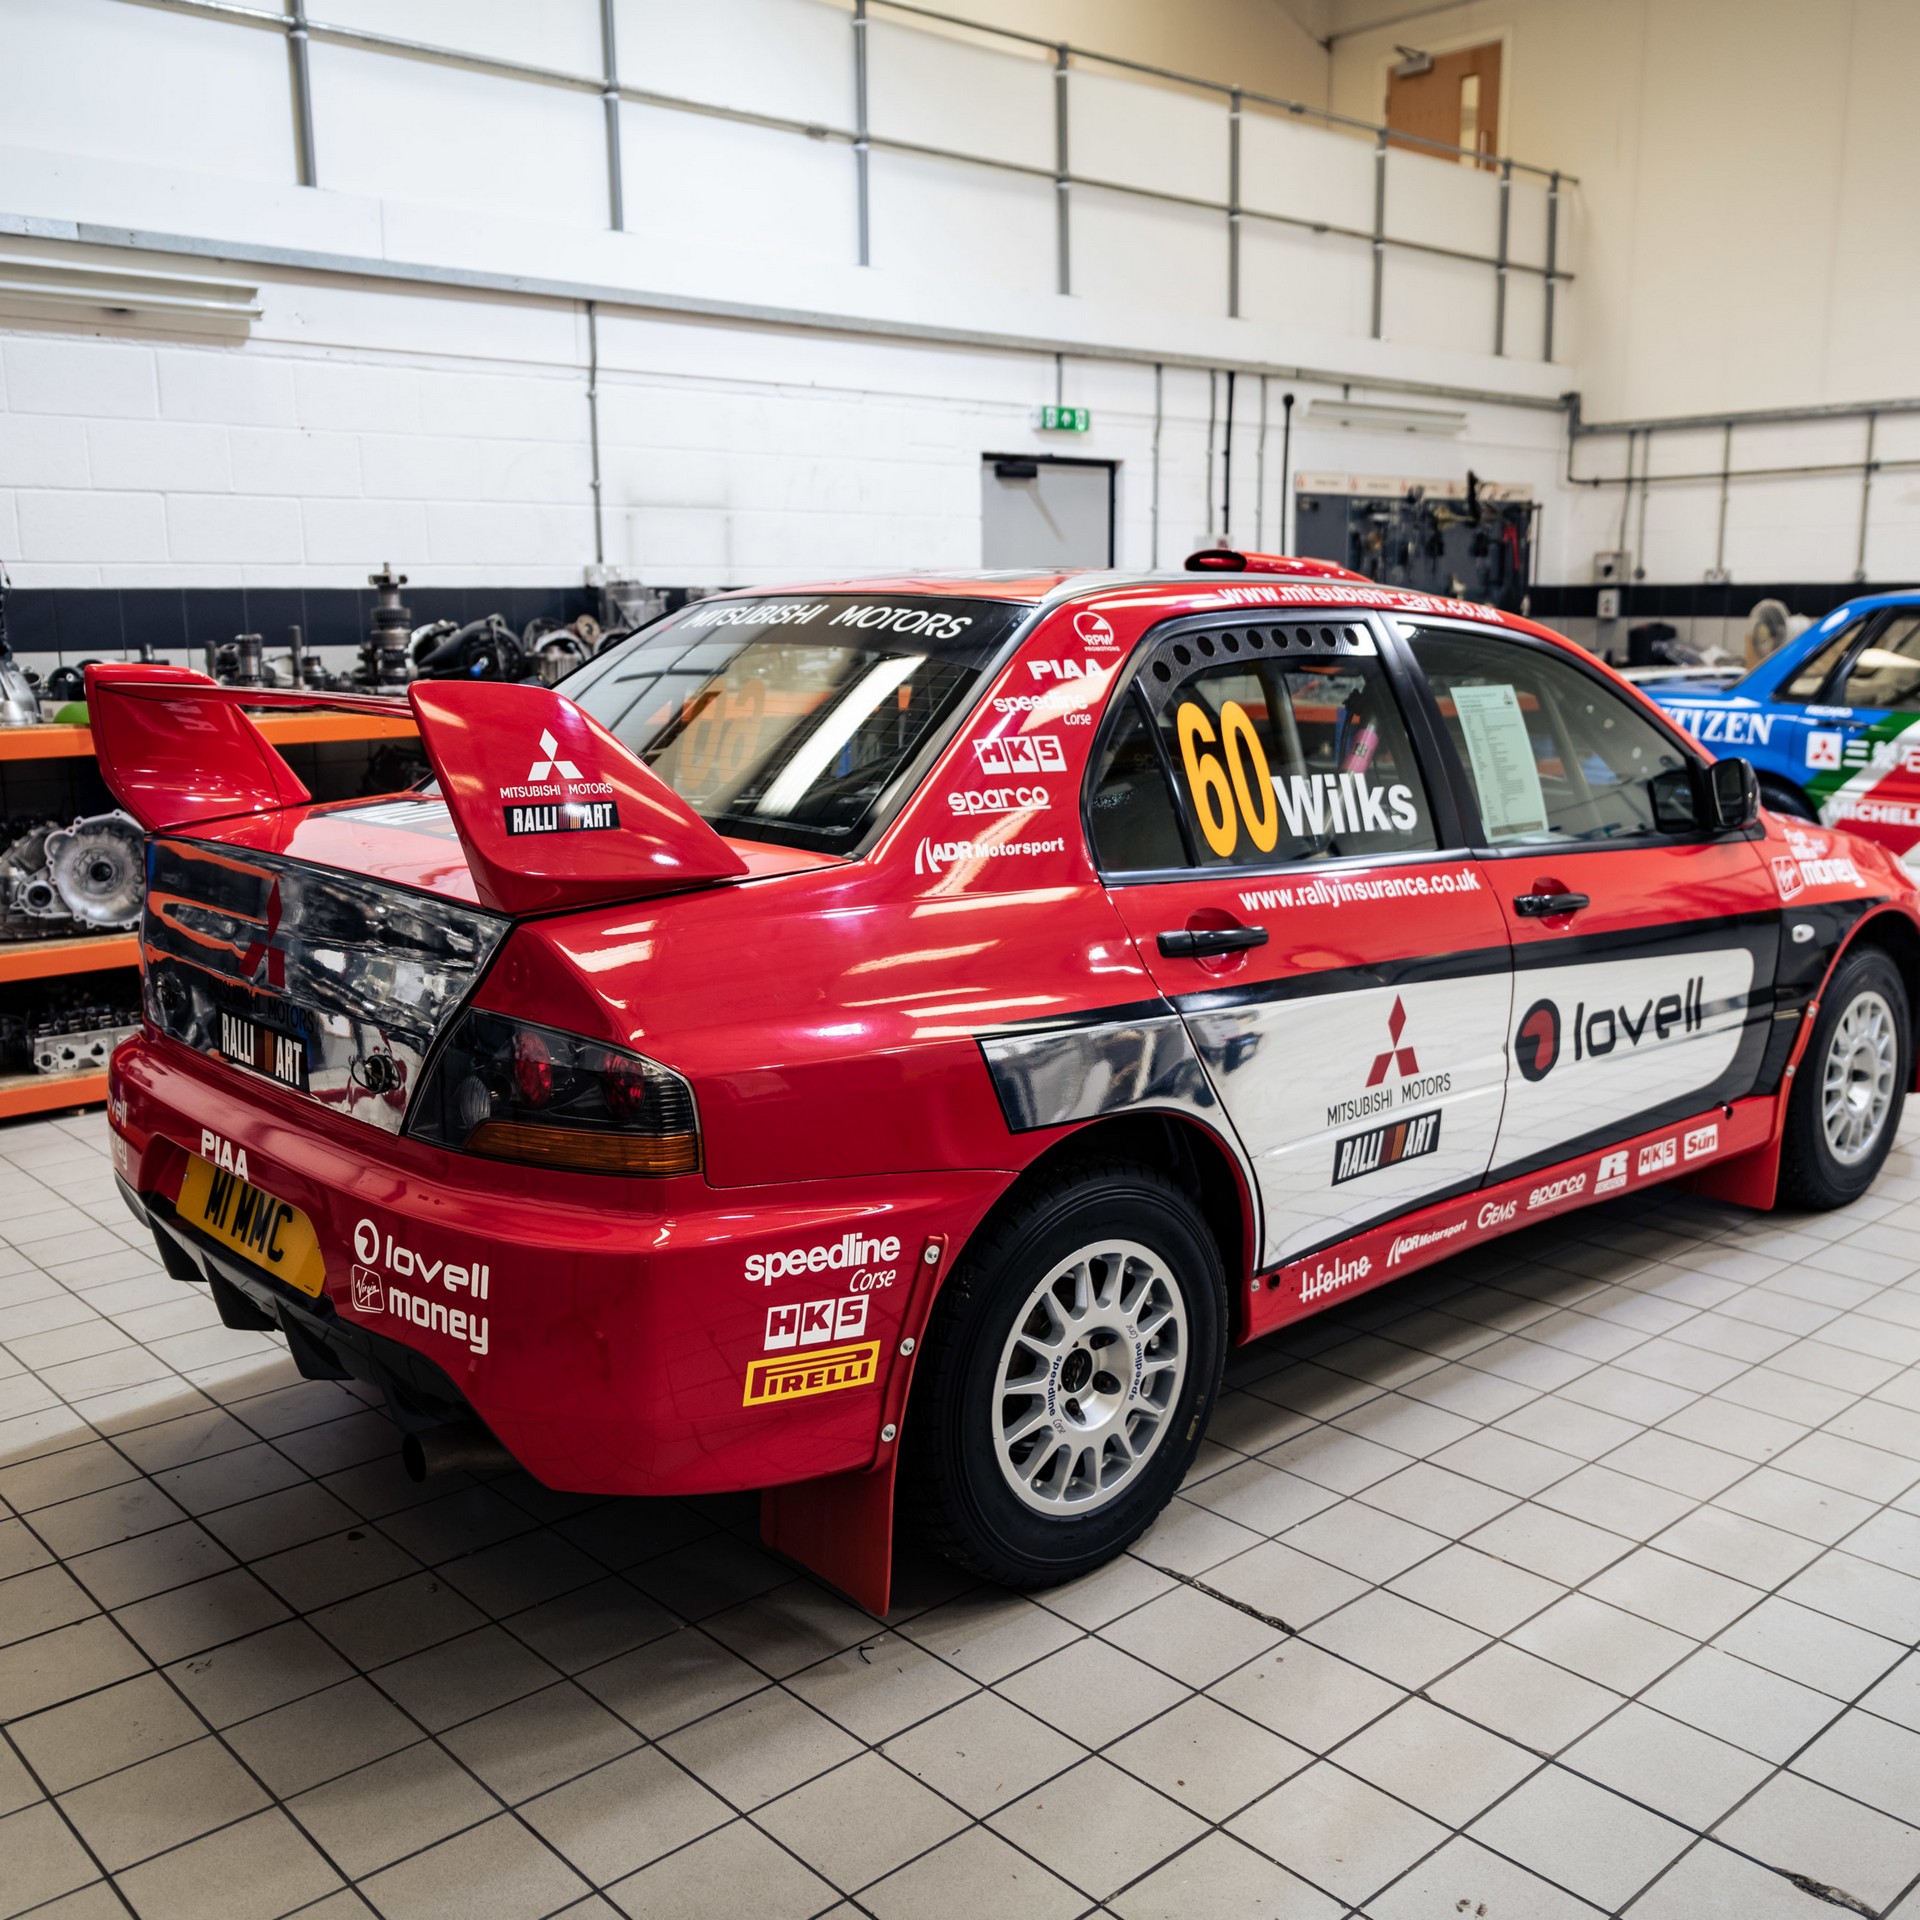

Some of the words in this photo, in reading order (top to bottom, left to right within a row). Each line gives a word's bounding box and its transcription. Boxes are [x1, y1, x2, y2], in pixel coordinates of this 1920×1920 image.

[680, 603, 829, 630] MITSUBISHI
[828, 604, 973, 639] MOTORS
[1218, 584, 1504, 623] www.mitsubishi-cars.co.uk
[1085, 634, 1113, 645] RPM
[1026, 658, 1107, 680] PIAA
[992, 690, 1089, 716] speedline
[1063, 711, 1092, 726] Corse
[1660, 707, 1775, 747] TIZEN
[975, 737, 1063, 766] HKS
[499, 784, 562, 799] MITSUBISHI
[568, 782, 613, 795] MOTORS
[1176, 700, 1279, 858] 60
[1270, 772, 1418, 837] Wilks
[512, 805, 558, 833] RALLI
[947, 785, 1051, 815] sparco
[931, 840, 975, 863] ADR
[975, 836, 1065, 858] Motorsport
[1238, 867, 1482, 912] www.rallyinsurance.co.uk
[1799, 857, 1867, 889] money
[1573, 975, 1704, 1062] lovell
[221, 1012, 255, 1066] RALLI
[1326, 1088, 1393, 1127] MITSUBISHI
[1401, 1072, 1452, 1104] MOTORS
[200, 1128, 250, 1183] PIAA
[1337, 1129, 1385, 1181] RALLI
[1640, 1140, 1675, 1168] HKS
[1527, 1172, 1587, 1210] sparco
[230, 1181, 294, 1263] MMC
[1398, 1233, 1419, 1255] ADR
[1419, 1220, 1468, 1248] Motorsport
[385, 1234, 490, 1301] lovell
[744, 1232, 901, 1287] speedline
[355, 1271, 380, 1307] Virgin
[849, 1268, 897, 1293] Corse
[388, 1286, 489, 1356] money
[767, 1298, 866, 1340] HKS
[749, 1347, 875, 1400] PIRELLI
[1047, 1355, 1063, 1417] speedline
[1128, 1342, 1143, 1401] speedline
